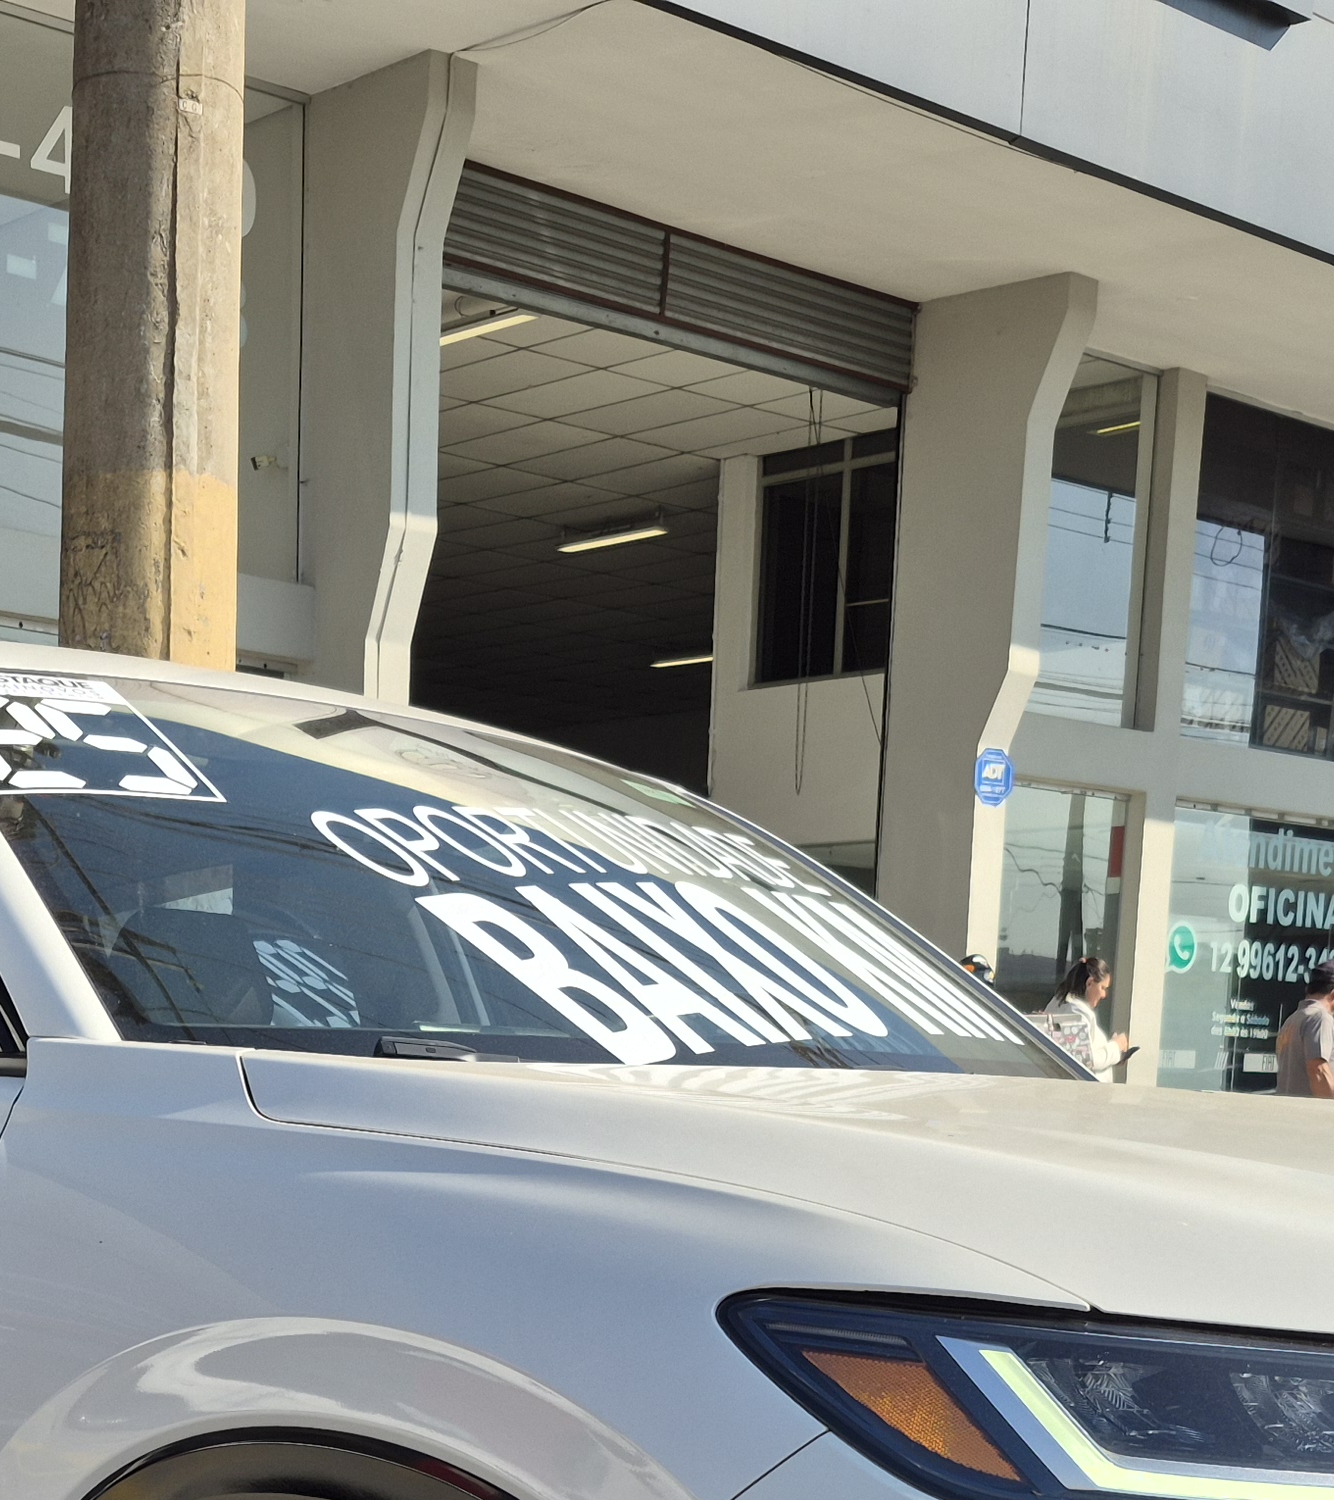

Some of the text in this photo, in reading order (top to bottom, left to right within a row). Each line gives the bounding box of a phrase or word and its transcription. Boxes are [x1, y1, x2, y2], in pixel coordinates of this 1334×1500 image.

[982, 763, 1006, 780] ADT
[310, 804, 832, 897] OPORTUNIDADE
[415, 879, 889, 1066] BAIXO
[1210, 941, 1233, 974] 12
